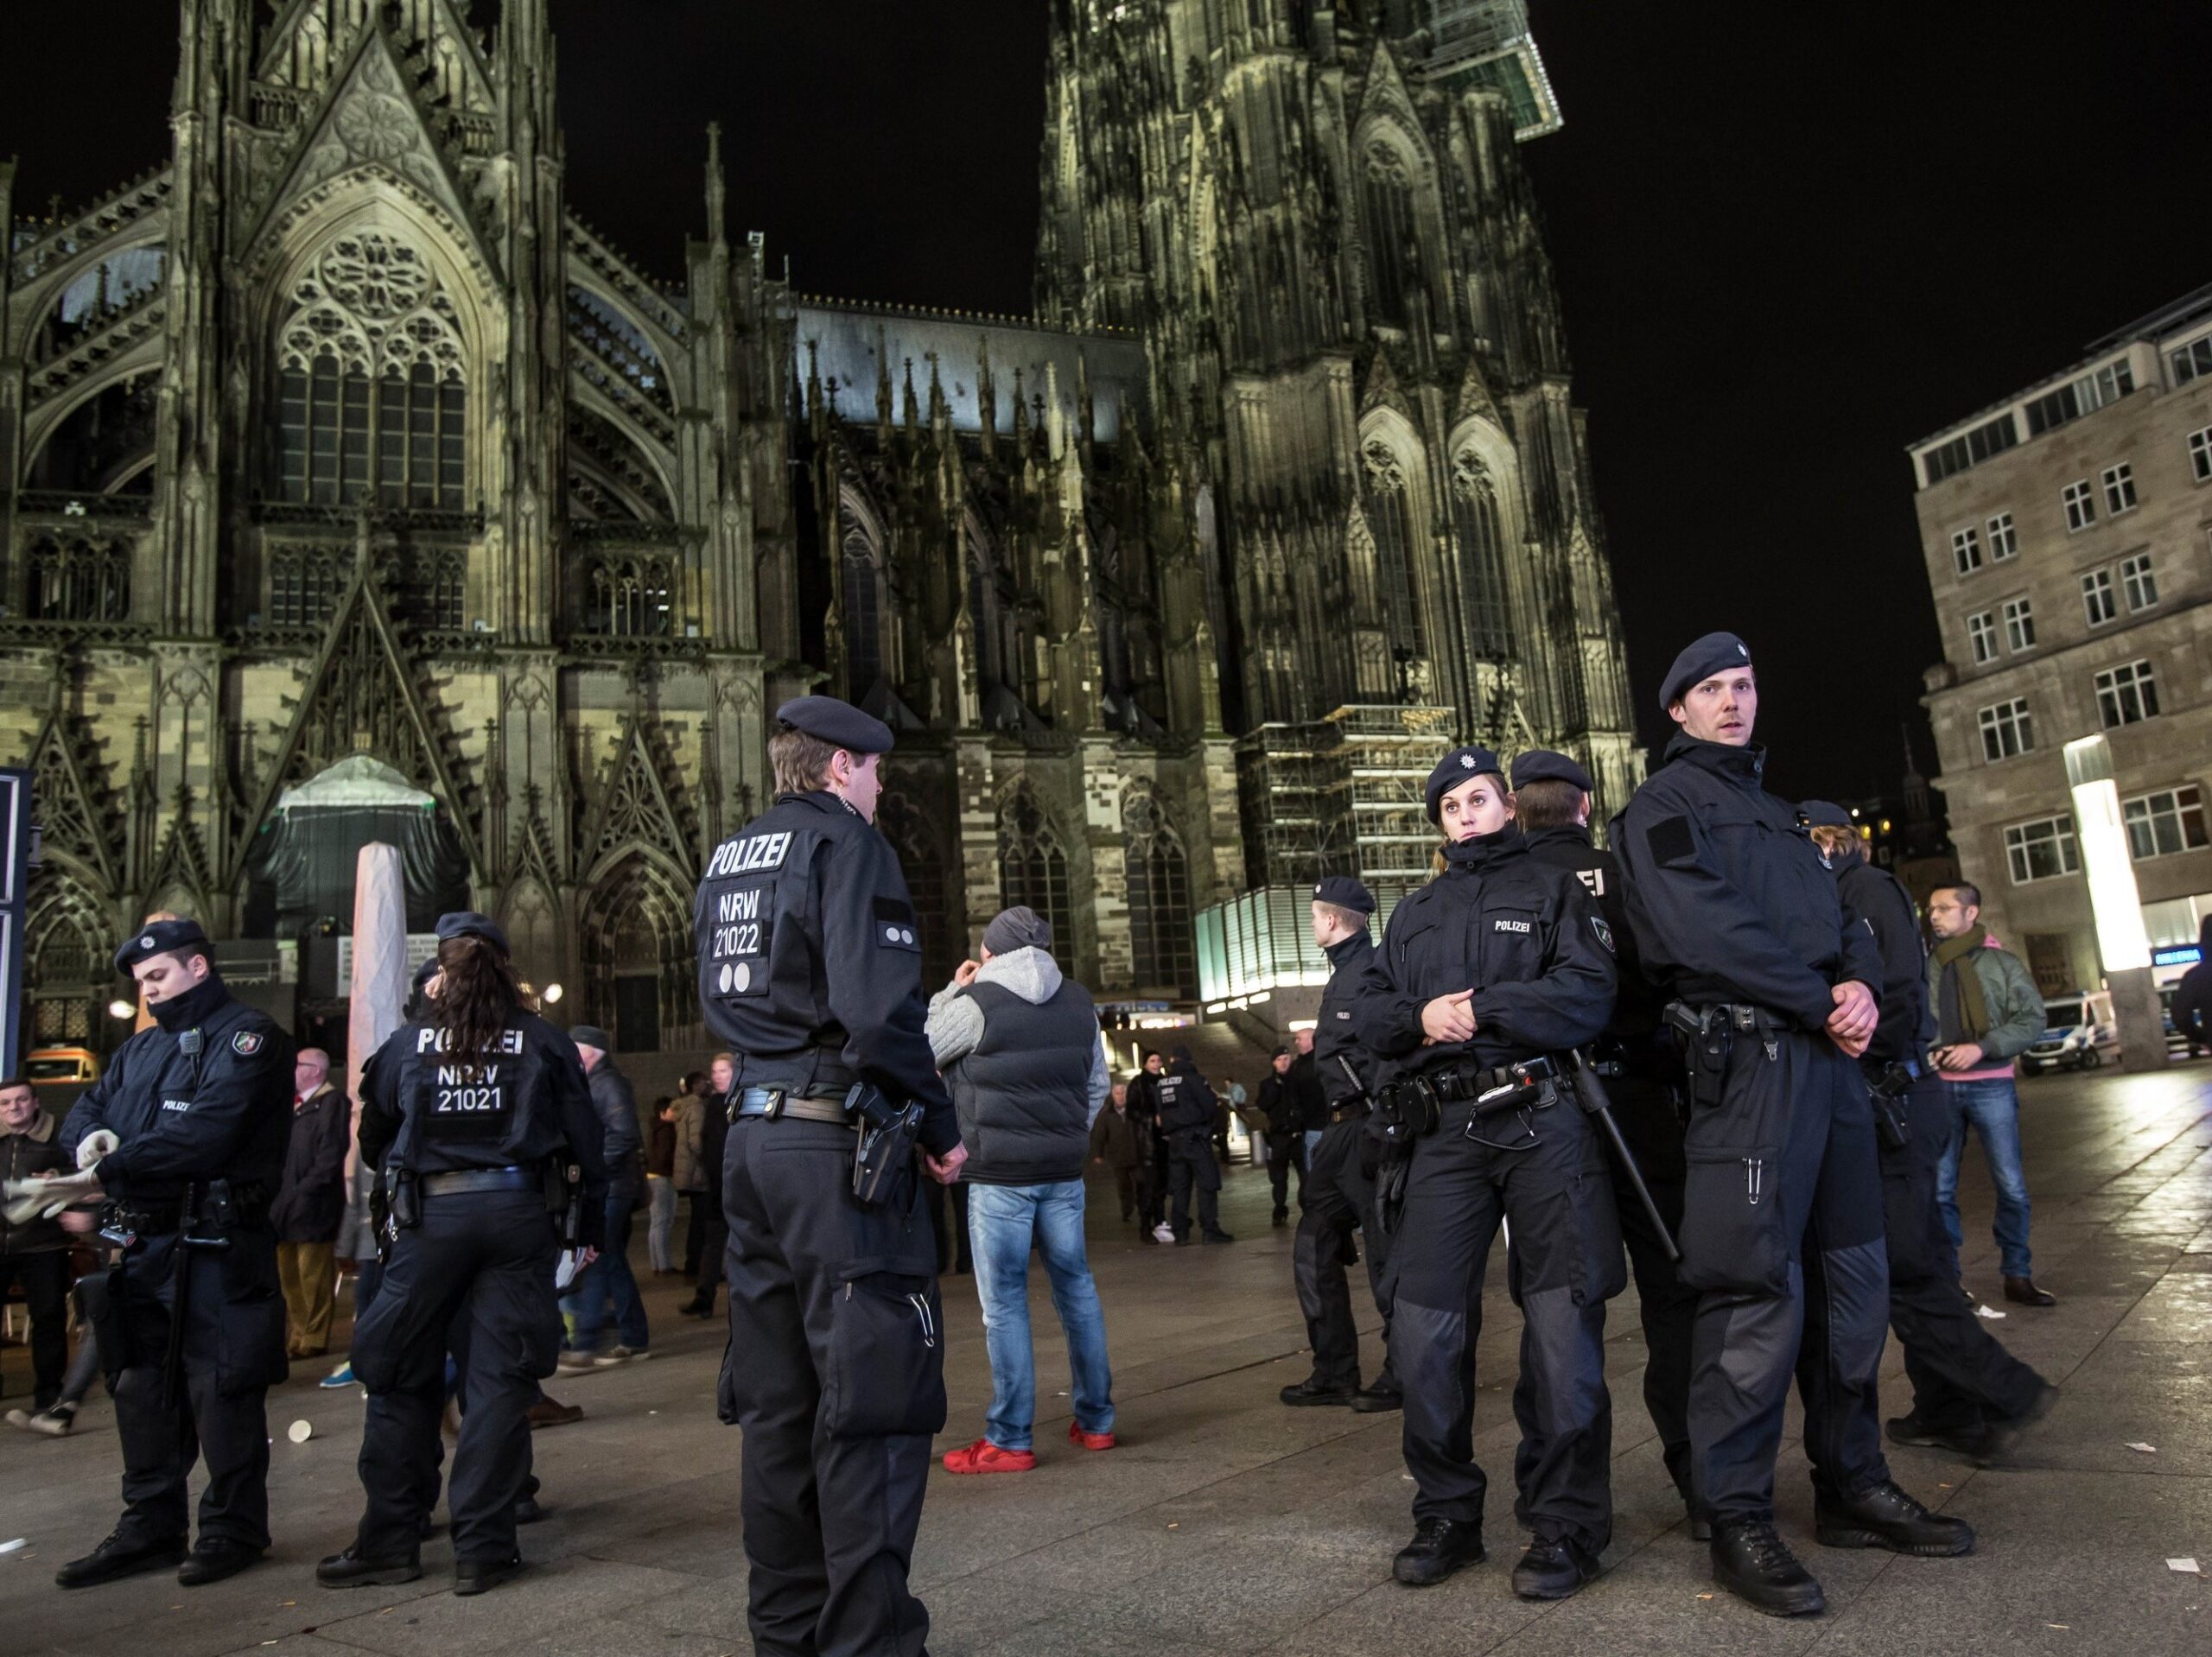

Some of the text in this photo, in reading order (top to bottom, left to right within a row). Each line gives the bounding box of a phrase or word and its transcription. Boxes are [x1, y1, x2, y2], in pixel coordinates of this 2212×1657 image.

[705, 831, 792, 878] POLIZEI
[719, 889, 760, 923] NRW
[714, 923, 759, 958] 21022
[1495, 920, 1530, 933] POLIZEI
[416, 1027, 524, 1055] POEI
[162, 1100, 191, 1112] POLIZE
[438, 1087, 501, 1112] 21021
